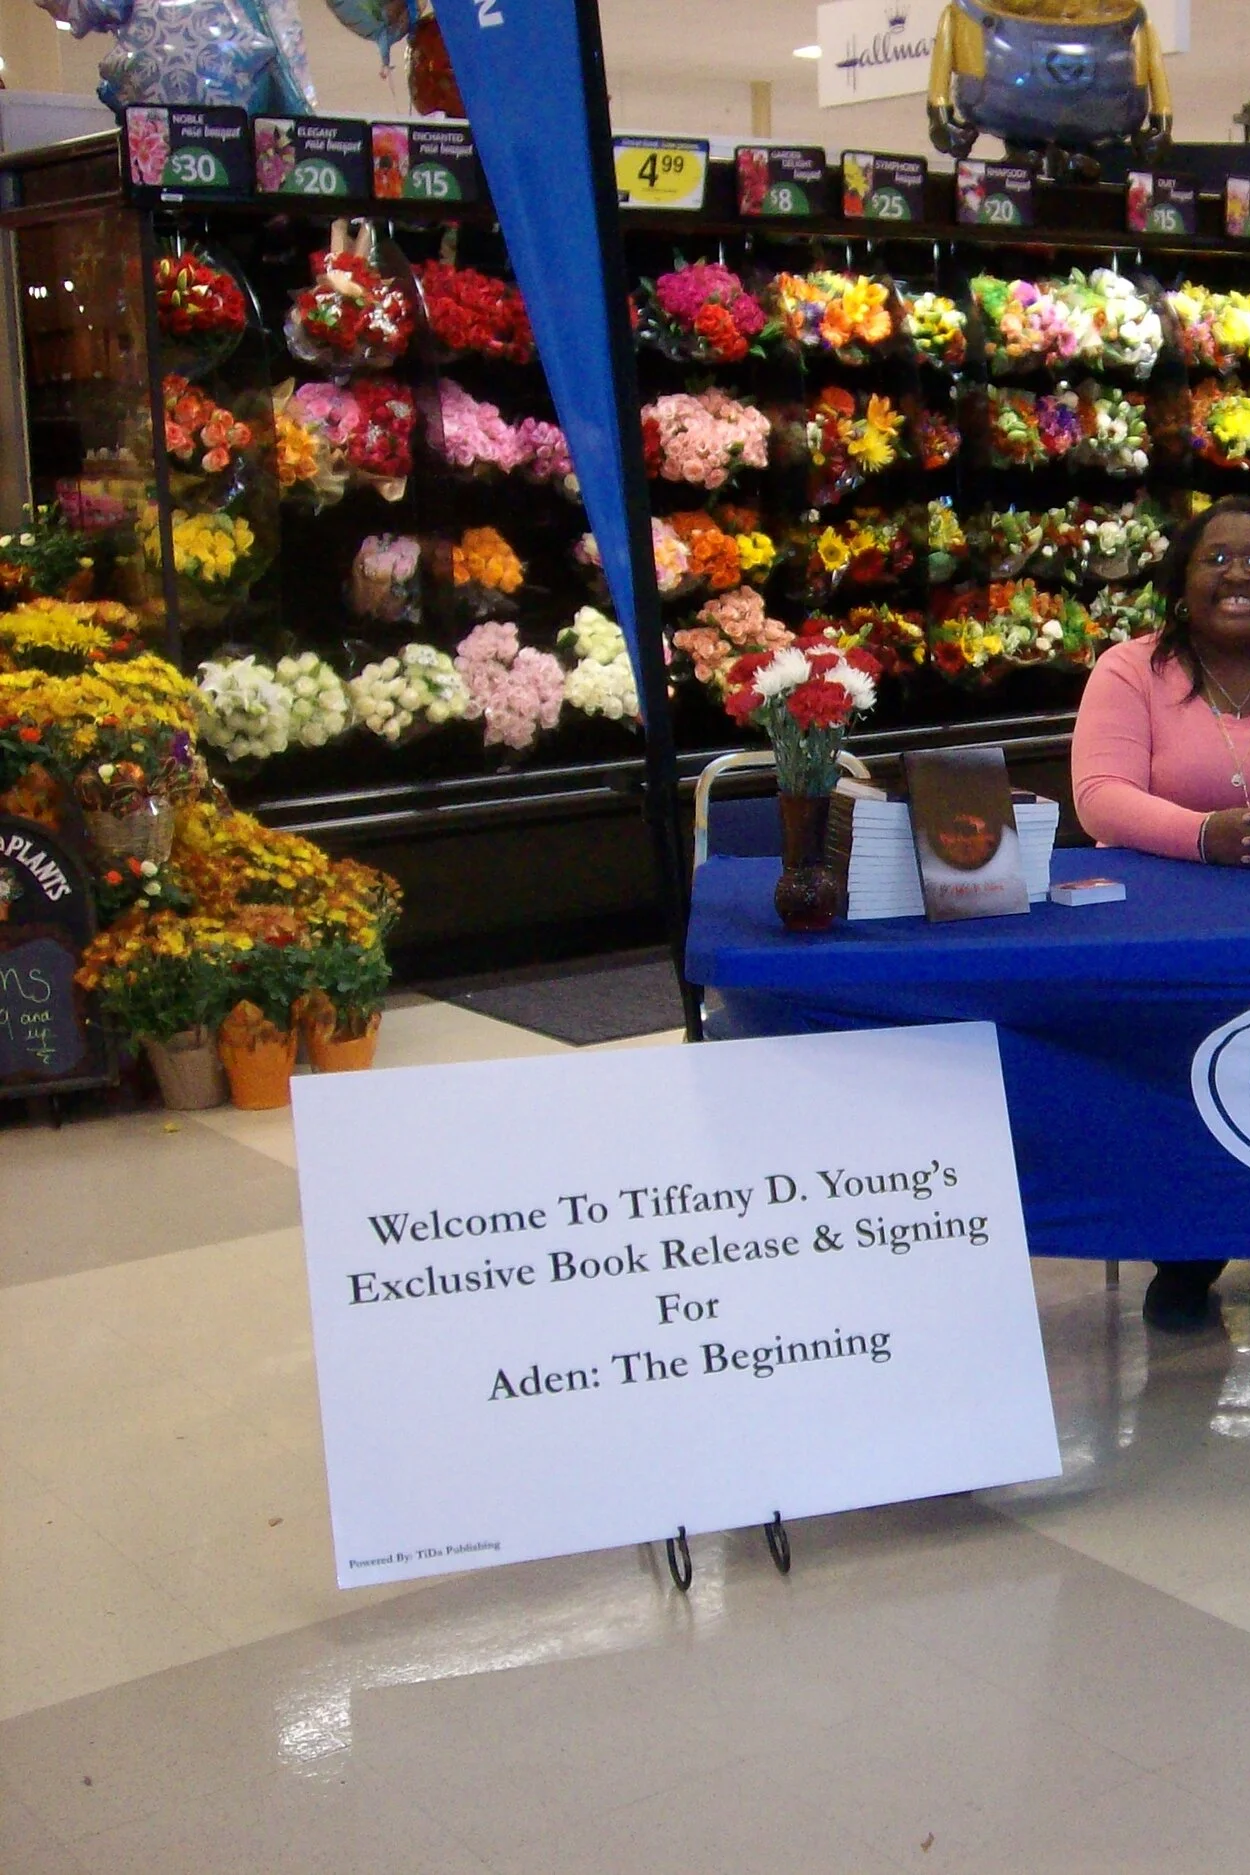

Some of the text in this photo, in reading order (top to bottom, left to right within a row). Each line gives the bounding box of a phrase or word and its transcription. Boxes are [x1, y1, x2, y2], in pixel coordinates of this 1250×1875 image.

[836, 32, 936, 93] Hallma
[172, 113, 205, 124] NOBLE
[297, 126, 338, 138] ELEGANT
[172, 154, 216, 182] $30
[294, 166, 336, 194] $20
[412, 170, 448, 197] $15
[770, 188, 793, 212] $8
[872, 194, 904, 217] $25
[984, 200, 1013, 222] $20
[1154, 209, 1176, 231] $15
[4, 835, 72, 901] PLANTS
[368, 1159, 958, 1246] Welcome To Tiffany D. Young's
[346, 1210, 989, 1305] Exclusive Book Release & Signing
[656, 1293, 720, 1325] For
[487, 1328, 892, 1401] Aden: The Beginning
[349, 1554, 393, 1569] Powered
[446, 1541, 501, 1556] Publishing
